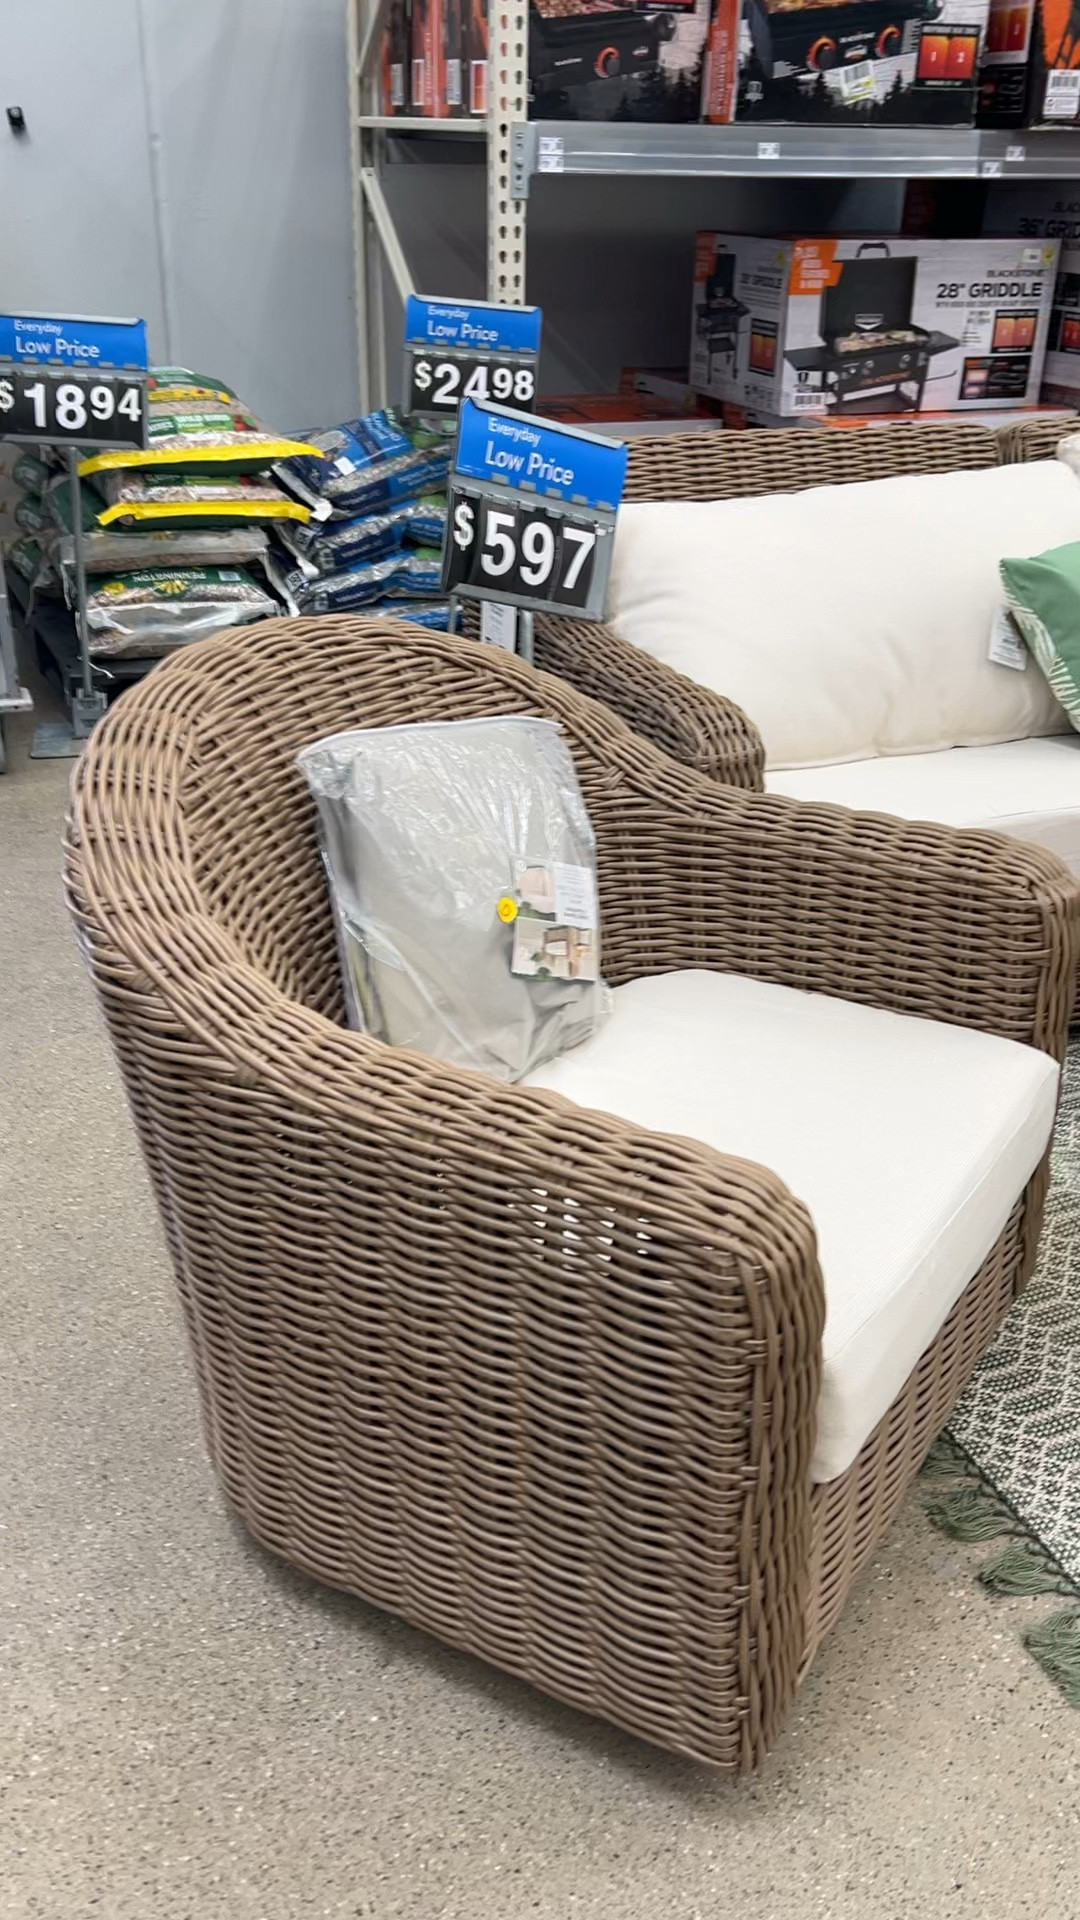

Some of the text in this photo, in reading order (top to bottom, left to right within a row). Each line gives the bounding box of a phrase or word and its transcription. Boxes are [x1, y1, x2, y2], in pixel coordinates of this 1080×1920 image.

[968, 282, 1044, 298] GRIDDLE
[427, 305, 470, 321] Everyday
[14, 320, 64, 336] Everyday
[427, 320, 500, 341] Low Price
[15, 336, 101, 358] Low Price
[487, 417, 542, 447] Everyday
[485, 440, 575, 486] Low Price
[132, 570, 207, 583] PENNINGTON
